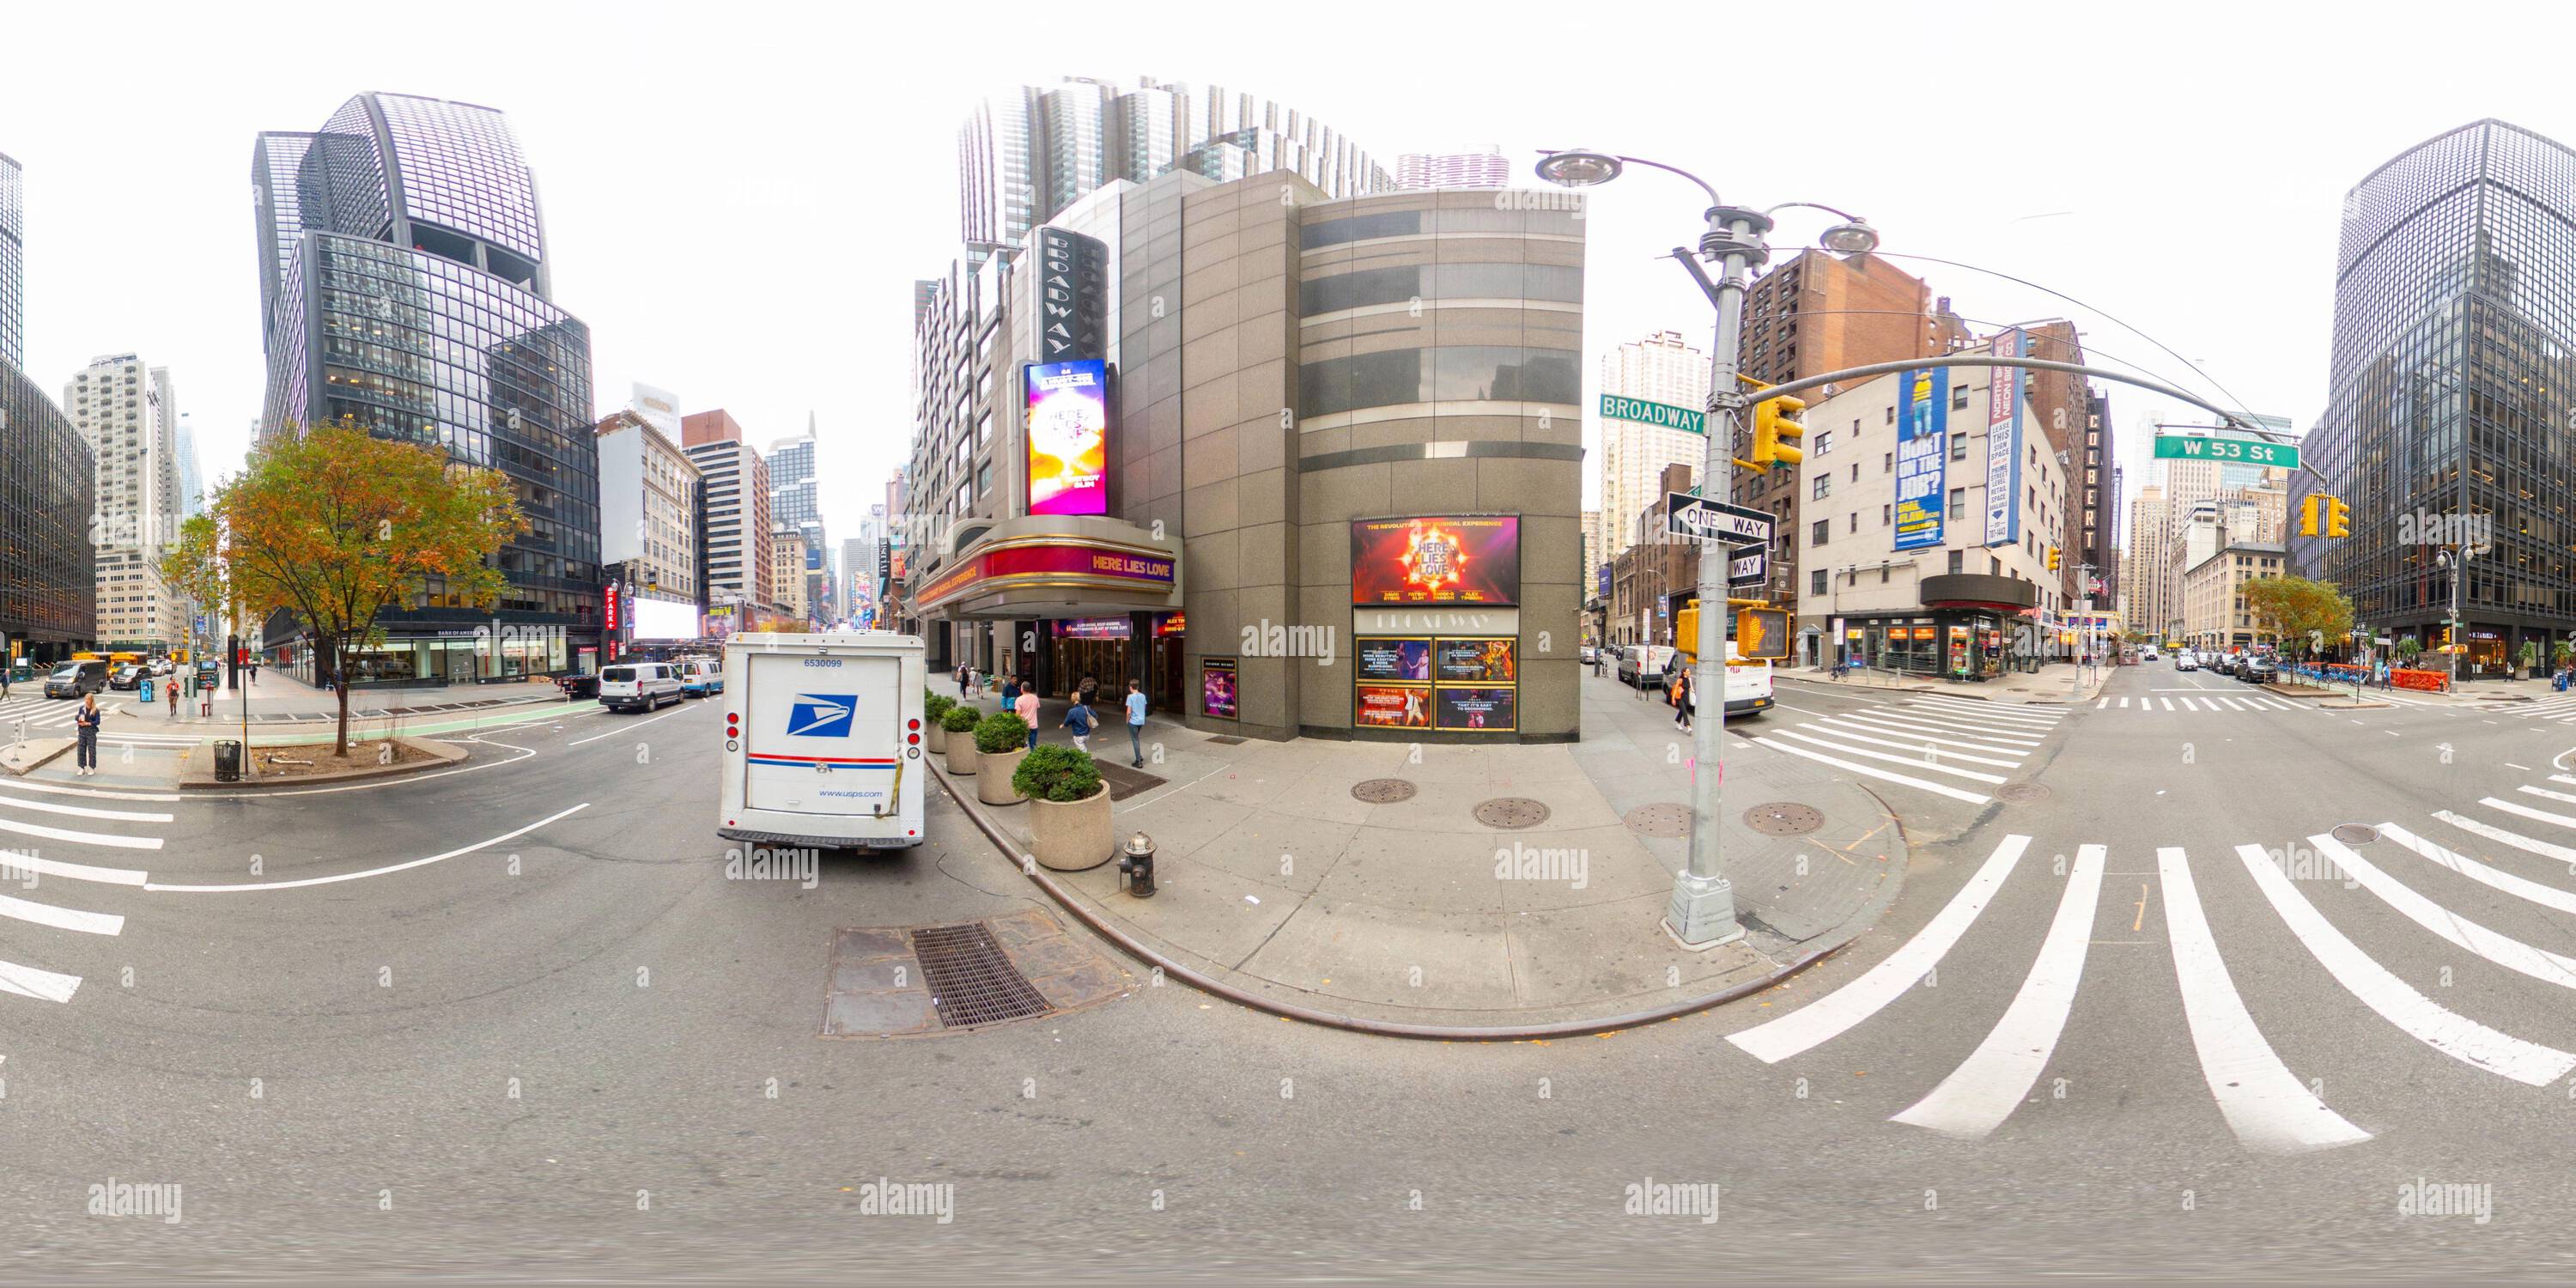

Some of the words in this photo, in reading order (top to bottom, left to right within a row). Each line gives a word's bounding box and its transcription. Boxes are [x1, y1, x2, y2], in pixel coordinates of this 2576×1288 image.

[1045, 235, 1072, 354] BROADWAY
[1995, 345, 2004, 379] SHRE
[1993, 380, 2002, 419] NORTH
[2002, 383, 2012, 416] NEON
[1603, 397, 1701, 431] BROADWAY
[1992, 422, 2009, 434] LEASE
[1993, 429, 2009, 443] THIS
[1899, 431, 1943, 463] HURT
[1991, 448, 2009, 461] SPACE
[1994, 441, 2008, 452] SIGN
[2184, 440, 2202, 455] W
[2211, 442, 2241, 458] 53
[2250, 446, 2274, 461] St
[1899, 459, 1917, 478] ON
[1918, 452, 1942, 473] THE
[1898, 471, 1941, 502] JOB?
[1990, 471, 2008, 482] STREET
[1992, 479, 2006, 488] LEVEL
[2086, 415, 2098, 549] COLBERT
[1991, 494, 2006, 503] SPACE
[1687, 508, 1718, 527] ONE
[1734, 517, 1764, 537] WAY
[1419, 542, 1449, 554] HERE
[1093, 556, 1122, 572] HERE
[1123, 559, 1145, 574] LIES
[1146, 562, 1170, 577] LOVE
[1421, 553, 1446, 564] LIES
[1734, 557, 1757, 576] WAY
[1419, 564, 1449, 575] LOVE
[819, 789, 883, 799] www.usps.com
